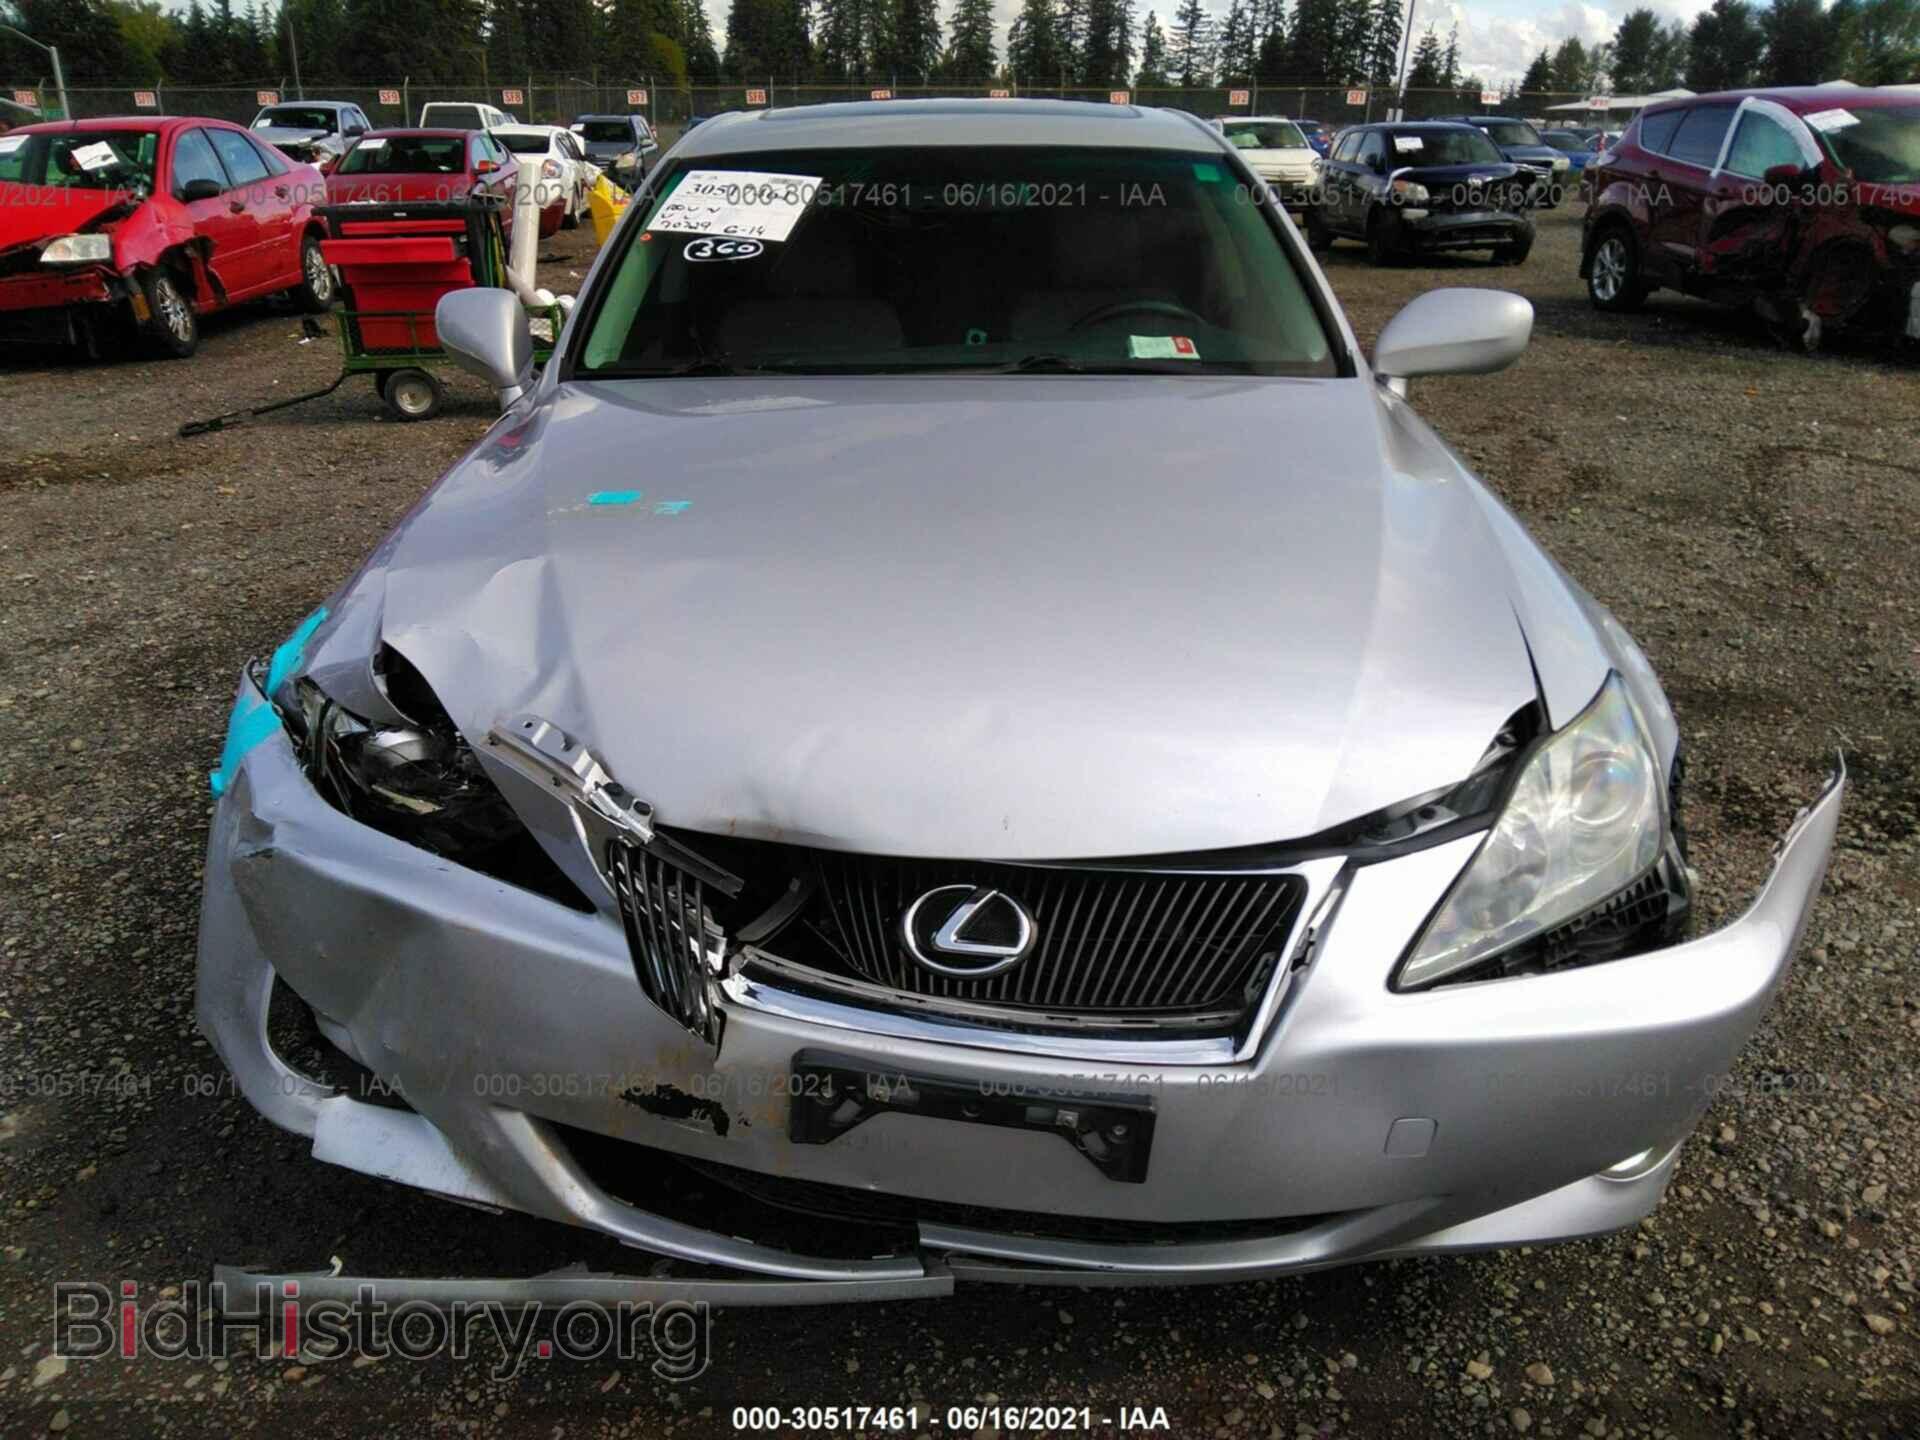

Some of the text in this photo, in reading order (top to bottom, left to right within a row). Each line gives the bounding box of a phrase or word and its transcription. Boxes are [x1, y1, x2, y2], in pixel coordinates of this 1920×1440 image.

[380, 91, 398, 104] SF9
[629, 91, 647, 103] SF7
[1111, 93, 1128, 104] SF3
[1231, 91, 1248, 103] SF2
[1349, 91, 1365, 103] SF1
[694, 240, 756, 257] 360
